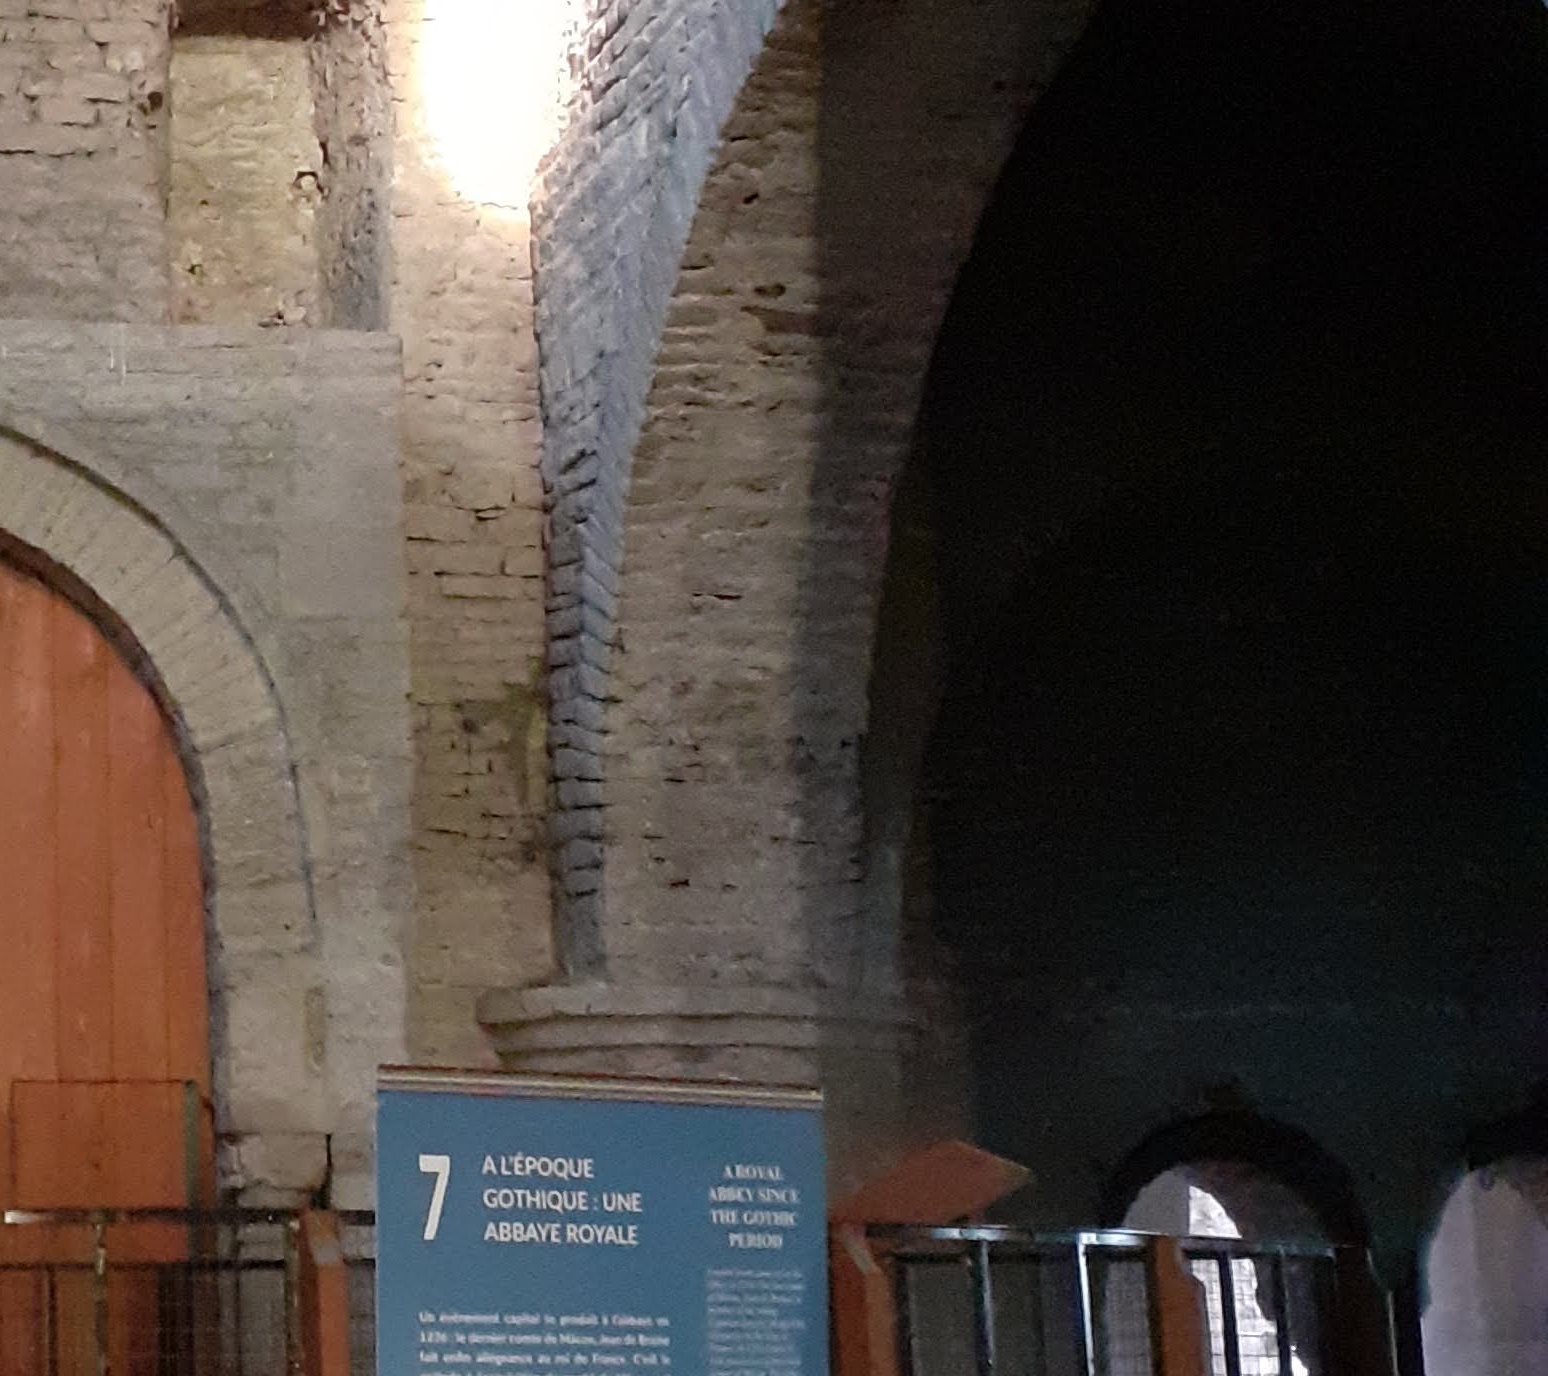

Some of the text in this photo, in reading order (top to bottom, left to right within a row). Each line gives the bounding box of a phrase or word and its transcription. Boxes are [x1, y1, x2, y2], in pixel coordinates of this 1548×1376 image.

[482, 1152, 594, 1179] A L'ÉPOQUE
[418, 1154, 450, 1241] 7
[483, 1189, 589, 1213] GOTHIQUE
[602, 1192, 643, 1212] UNE
[484, 1224, 639, 1245] ABBAYE ROYALE
